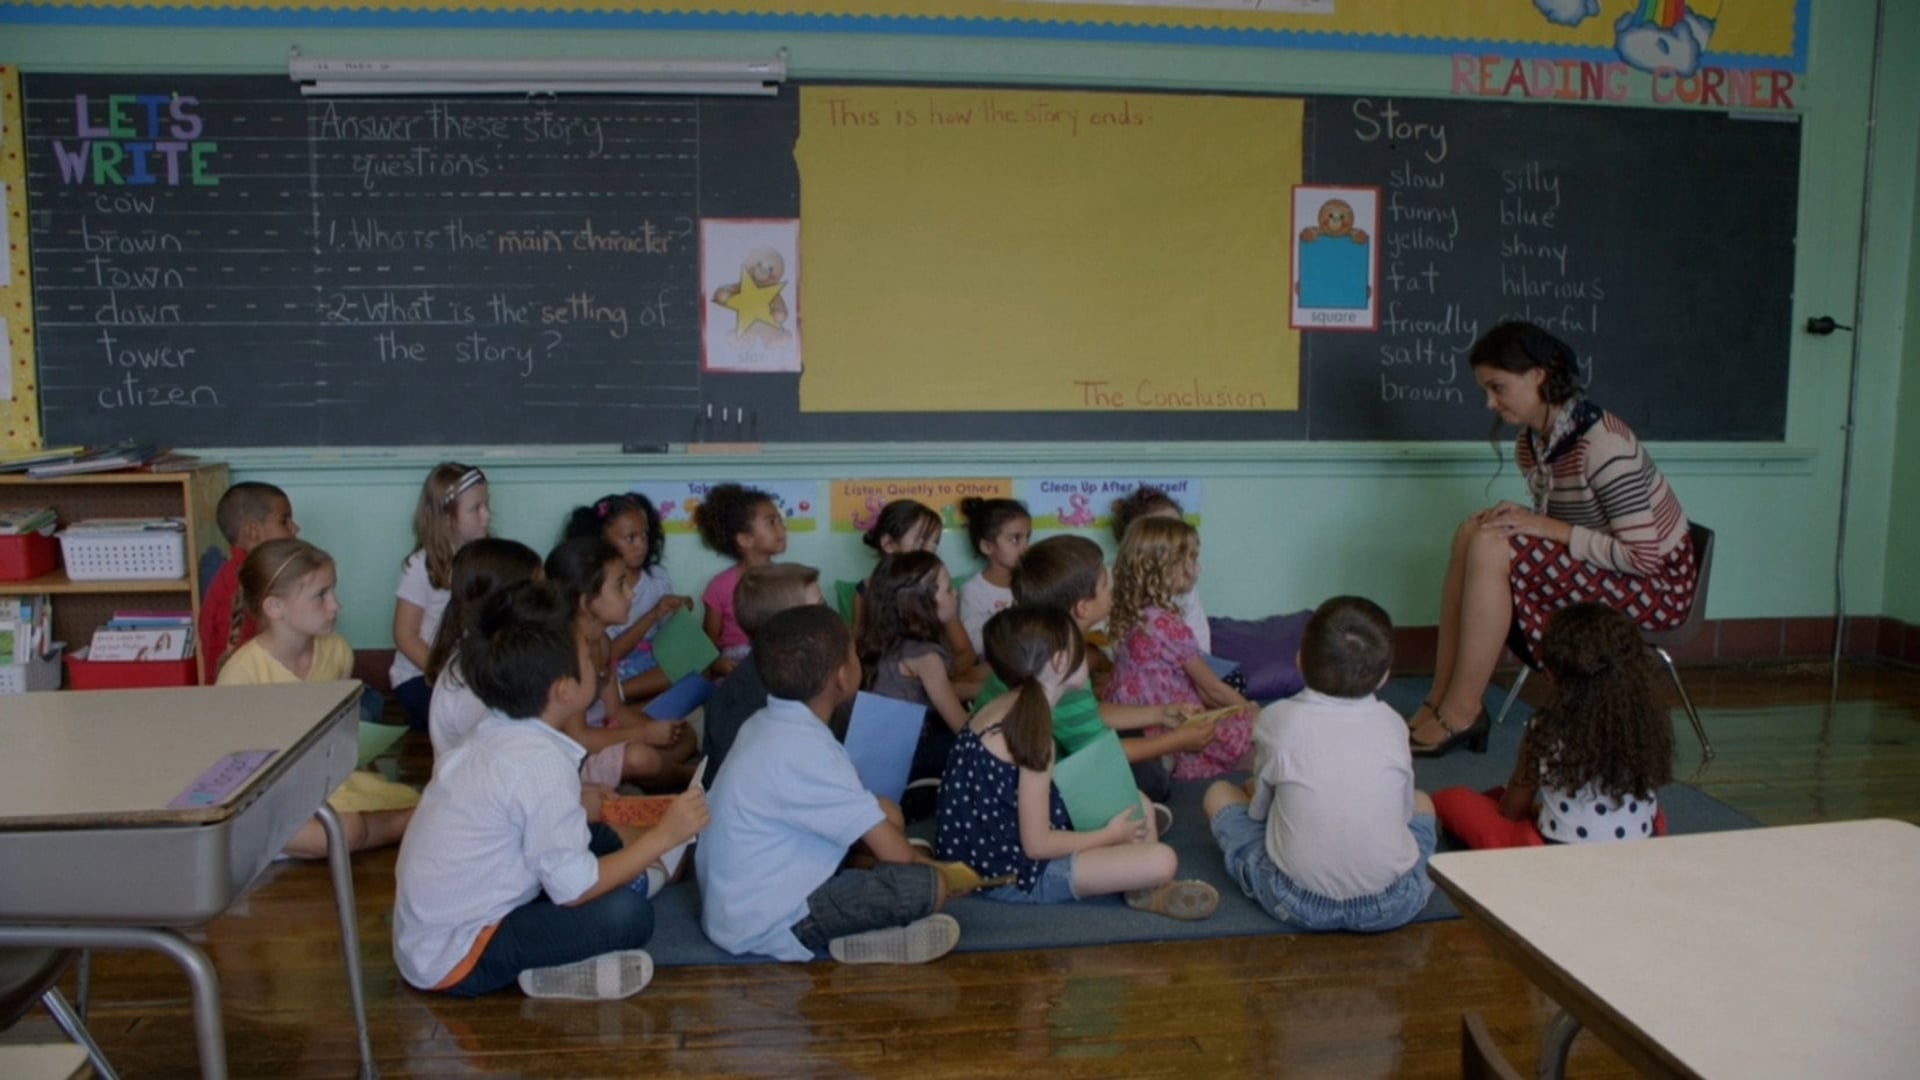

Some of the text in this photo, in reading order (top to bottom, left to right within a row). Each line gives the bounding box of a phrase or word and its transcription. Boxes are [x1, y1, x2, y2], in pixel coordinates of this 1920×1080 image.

[1450, 54, 1796, 109] READING CORNER
[75, 91, 203, 140] LET'S
[319, 101, 603, 156] Answer these story
[824, 100, 881, 127] This
[895, 103, 918, 126] is
[930, 99, 973, 126] how
[983, 100, 1019, 125] the
[1025, 99, 1079, 137] story
[1353, 98, 1448, 163] Story
[53, 141, 220, 186] WRITE
[353, 144, 503, 190] questions:
[1389, 162, 1445, 190] slow
[1503, 162, 1560, 208] silly
[95, 195, 155, 214] cow
[1387, 201, 1459, 240] funny
[1500, 201, 1556, 230] blue
[81, 215, 182, 253] brown
[329, 219, 346, 250] 1.
[351, 216, 405, 249] Who
[414, 230, 437, 249] is
[443, 219, 489, 251] the
[497, 226, 562, 252] main
[1387, 227, 1456, 258] yellow
[1501, 236, 1568, 276] shiny
[1387, 261, 1440, 295] fat
[1501, 264, 1605, 301] hilarious
[95, 289, 181, 325] down
[327, 287, 673, 338] 2. What is the setting of
[1310, 308, 1357, 325] square
[1382, 302, 1478, 352] friendly
[96, 329, 196, 368] tower
[374, 331, 428, 364] the
[1380, 338, 1457, 385] salty
[98, 371, 218, 409] citizen
[1073, 377, 1267, 409] The Conclusion
[1380, 372, 1464, 404] brown
[843, 483, 999, 497] Listen Quietly to Others
[1040, 481, 1077, 493] Clean
[1081, 481, 1097, 495] Up
[1101, 480, 1133, 493] After
